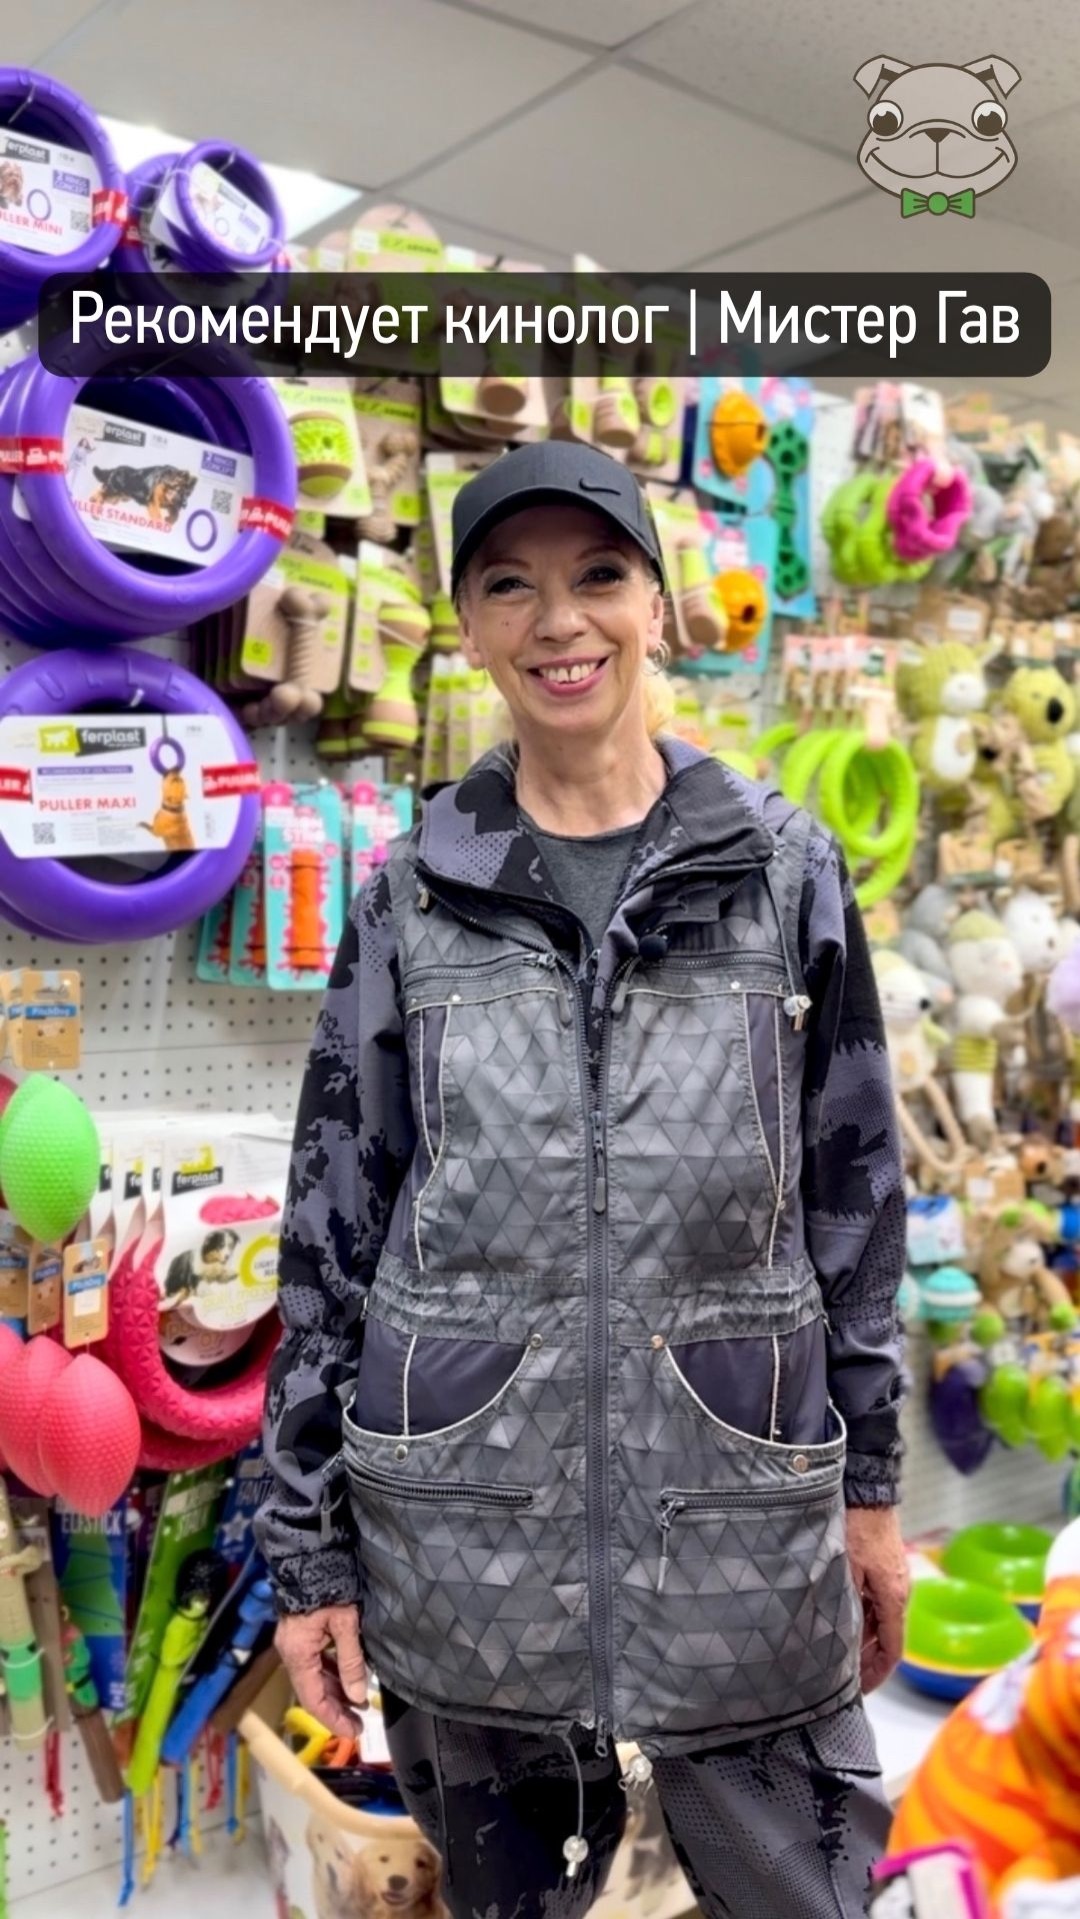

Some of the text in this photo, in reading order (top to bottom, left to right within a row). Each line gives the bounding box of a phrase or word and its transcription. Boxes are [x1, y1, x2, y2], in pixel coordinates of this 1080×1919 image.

[106, 508, 173, 534] STANDARD
[80, 728, 142, 747] ferplast
[39, 796, 137, 812] PULLER MAXI
